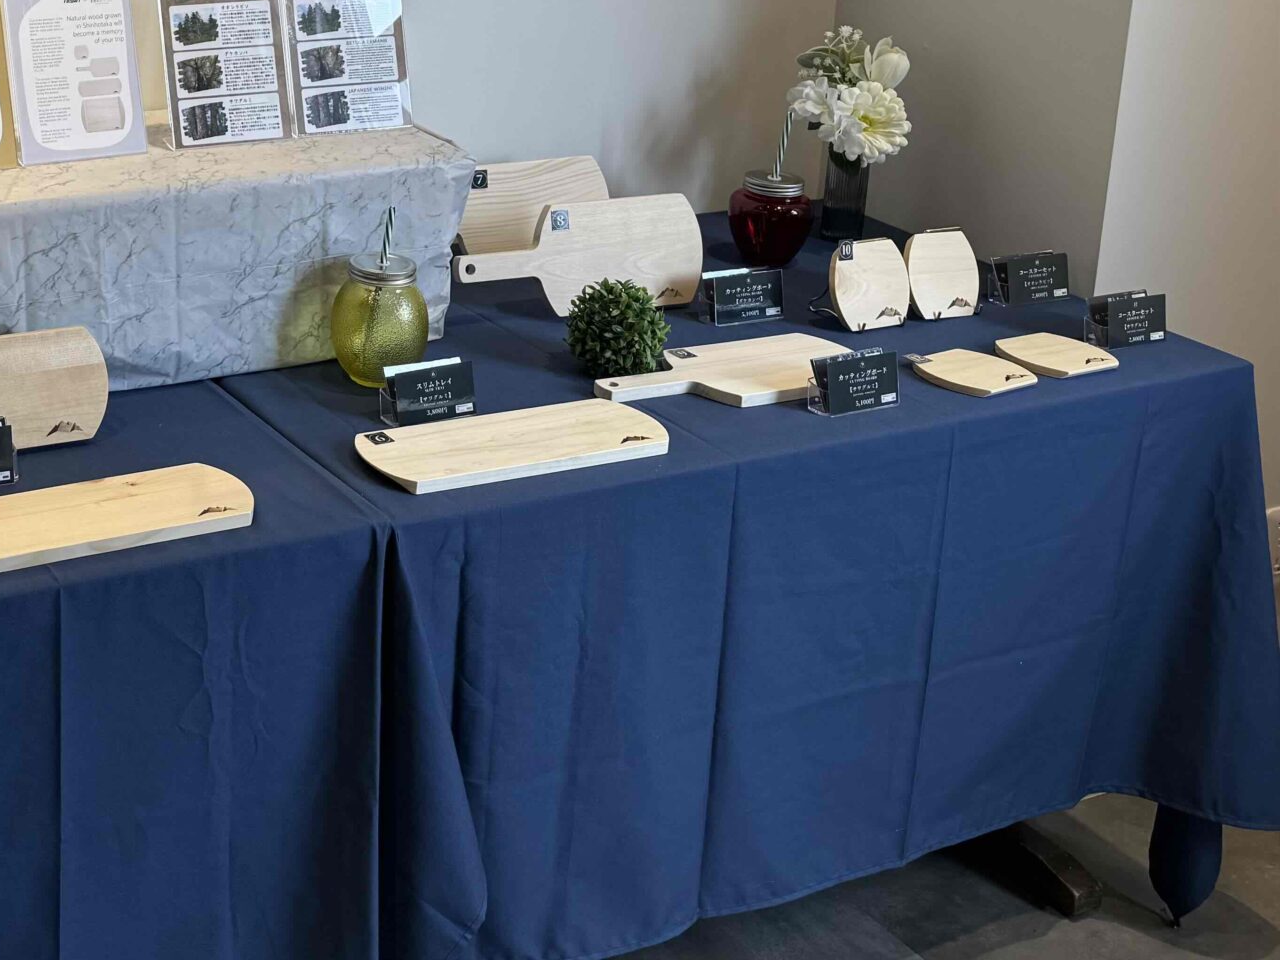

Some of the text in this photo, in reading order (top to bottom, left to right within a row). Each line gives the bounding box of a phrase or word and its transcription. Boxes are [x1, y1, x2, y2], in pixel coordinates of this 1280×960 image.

[842, 245, 851, 255] 10
[1019, 266, 1056, 275] コースターセット
[1118, 308, 1154, 318] コースターセット
[839, 367, 887, 381] カッティングボード
[416, 378, 452, 390] スリムトレイ
